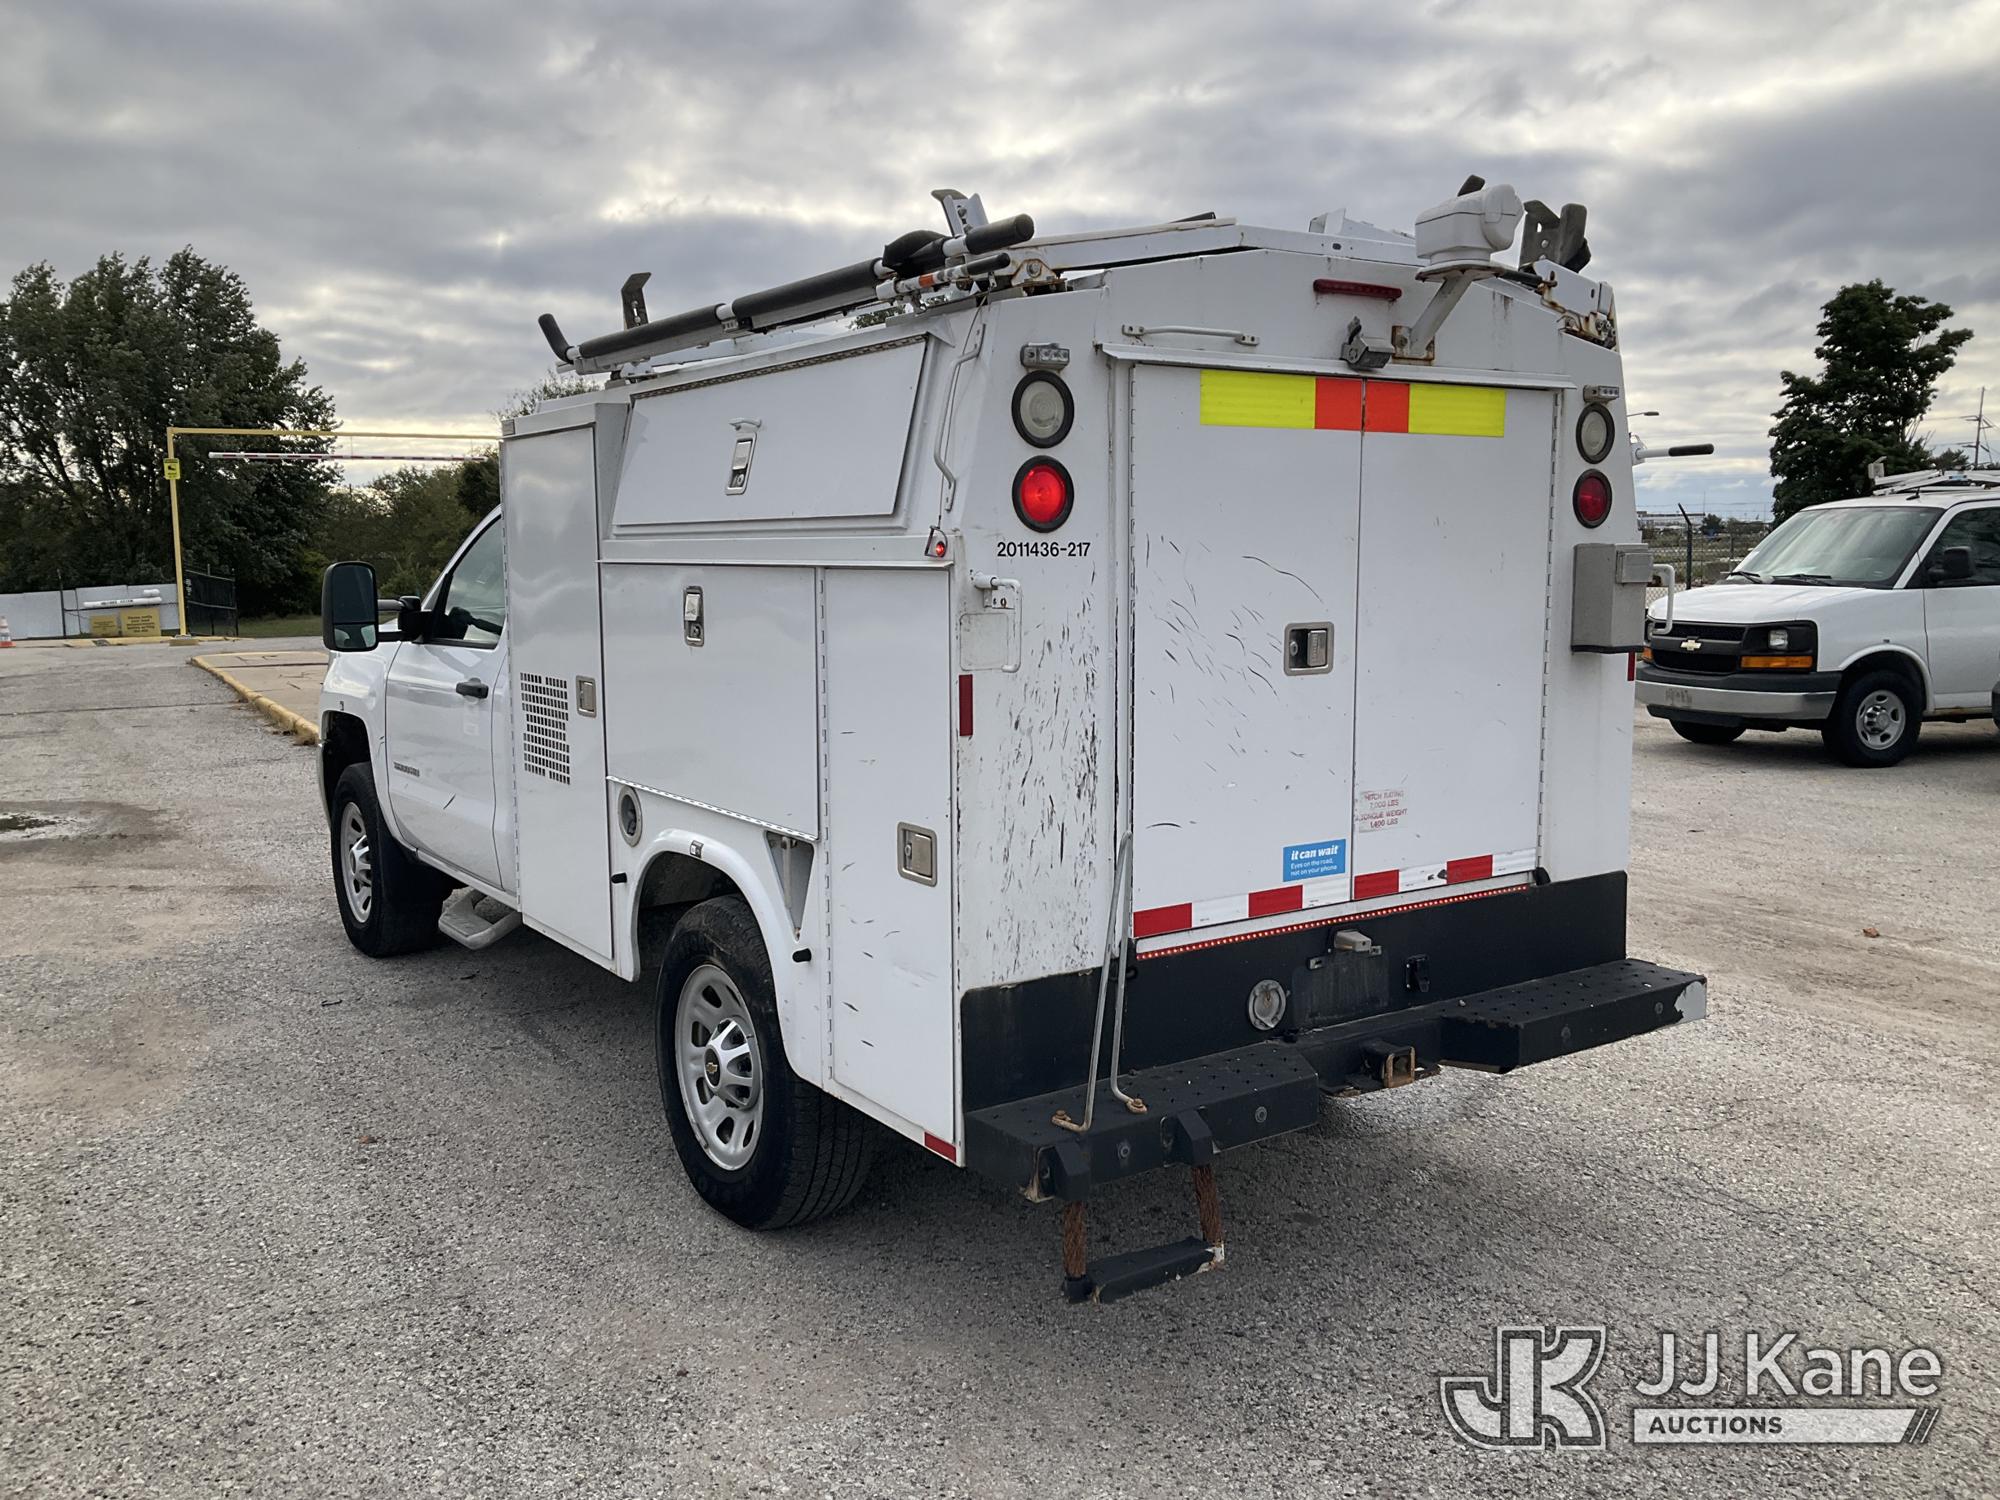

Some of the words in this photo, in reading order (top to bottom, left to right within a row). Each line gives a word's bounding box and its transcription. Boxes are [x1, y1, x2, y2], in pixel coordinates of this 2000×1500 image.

[997, 541, 1091, 557] 2011436-217
[1387, 799, 1399, 807] LBS
[1385, 808, 1408, 817] WEIGHT
[1386, 818, 1399, 826] LBS
[1291, 850, 1299, 861] it
[1299, 850, 1317, 860] can
[1318, 844, 1339, 857] wait
[1290, 862, 1303, 870] Eyes
[1311, 859, 1320, 867] the
[1290, 869, 1300, 877] not
[1308, 867, 1320, 875] your
[1320, 864, 1338, 873] phone
